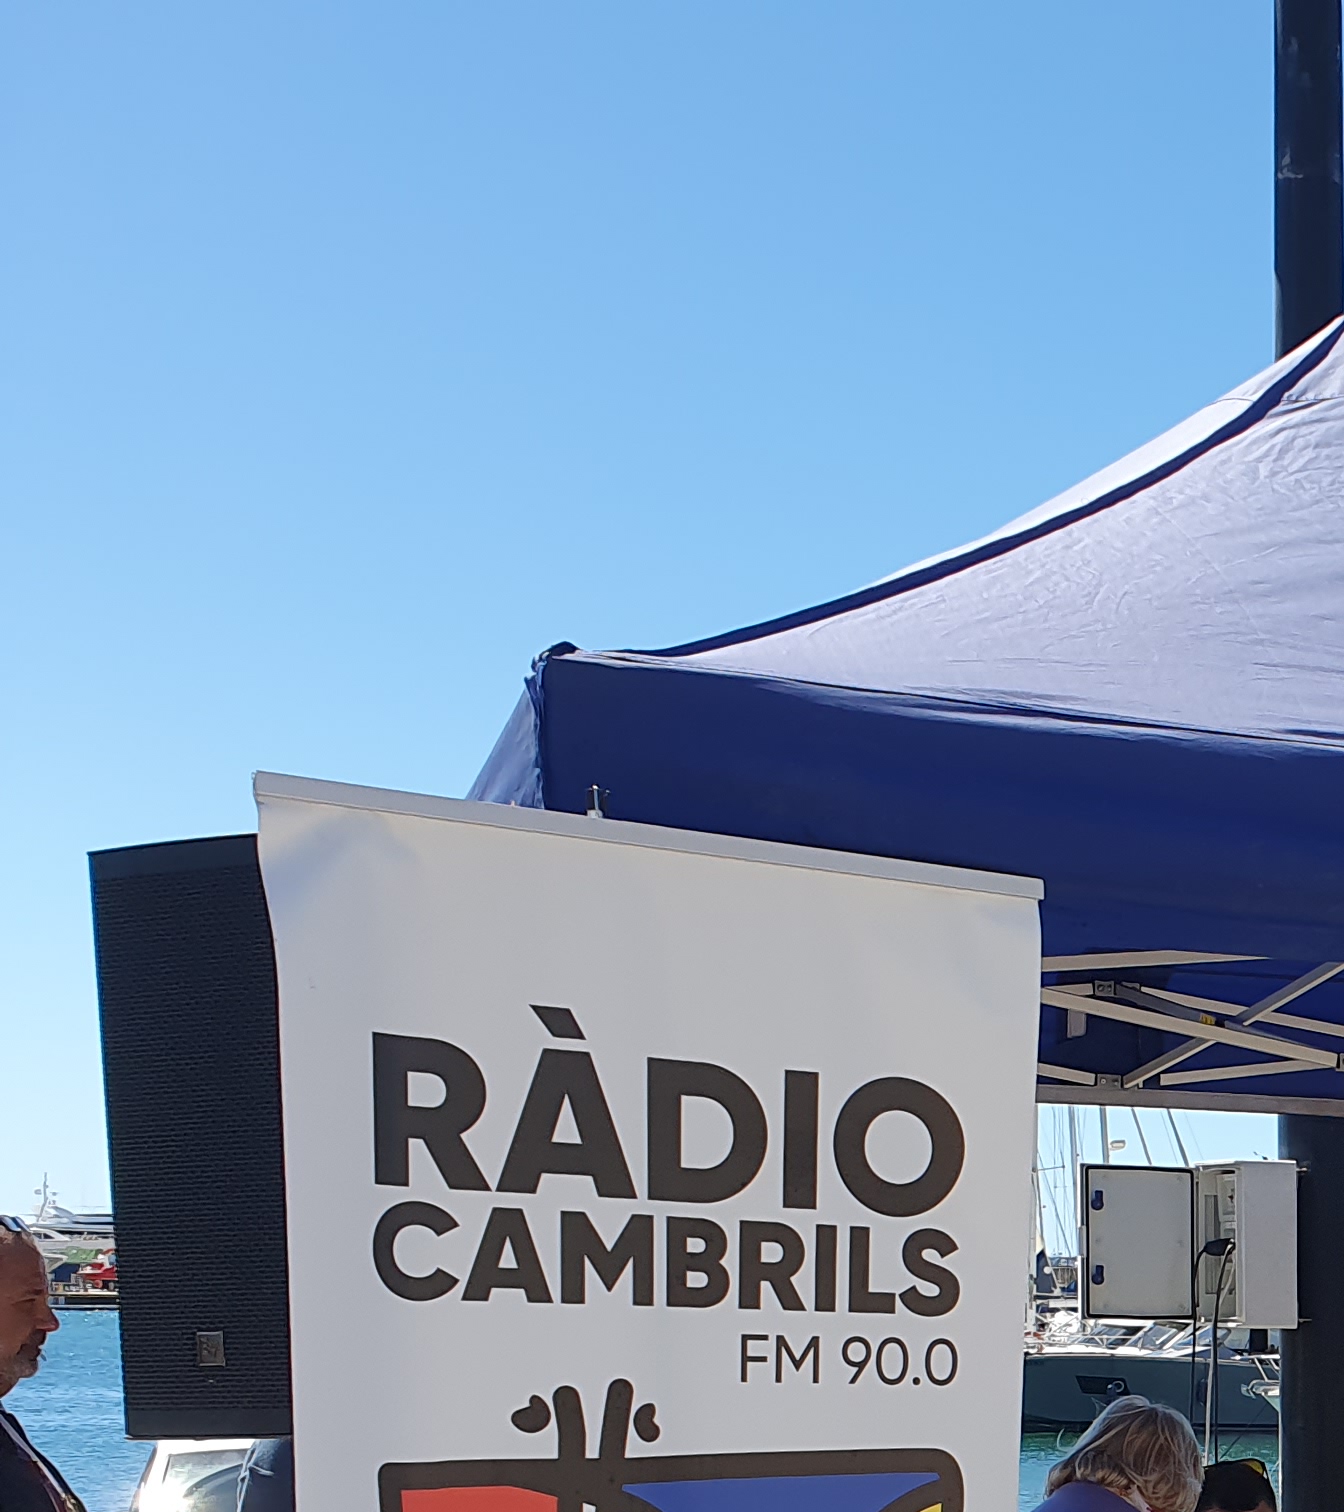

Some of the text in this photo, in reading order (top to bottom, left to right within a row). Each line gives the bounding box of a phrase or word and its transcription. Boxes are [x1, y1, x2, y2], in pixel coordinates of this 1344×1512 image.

[371, 1003, 966, 1219] RÀDIO
[372, 1200, 961, 1318] CAMBRILS
[740, 1333, 959, 1387] FM 90.0
